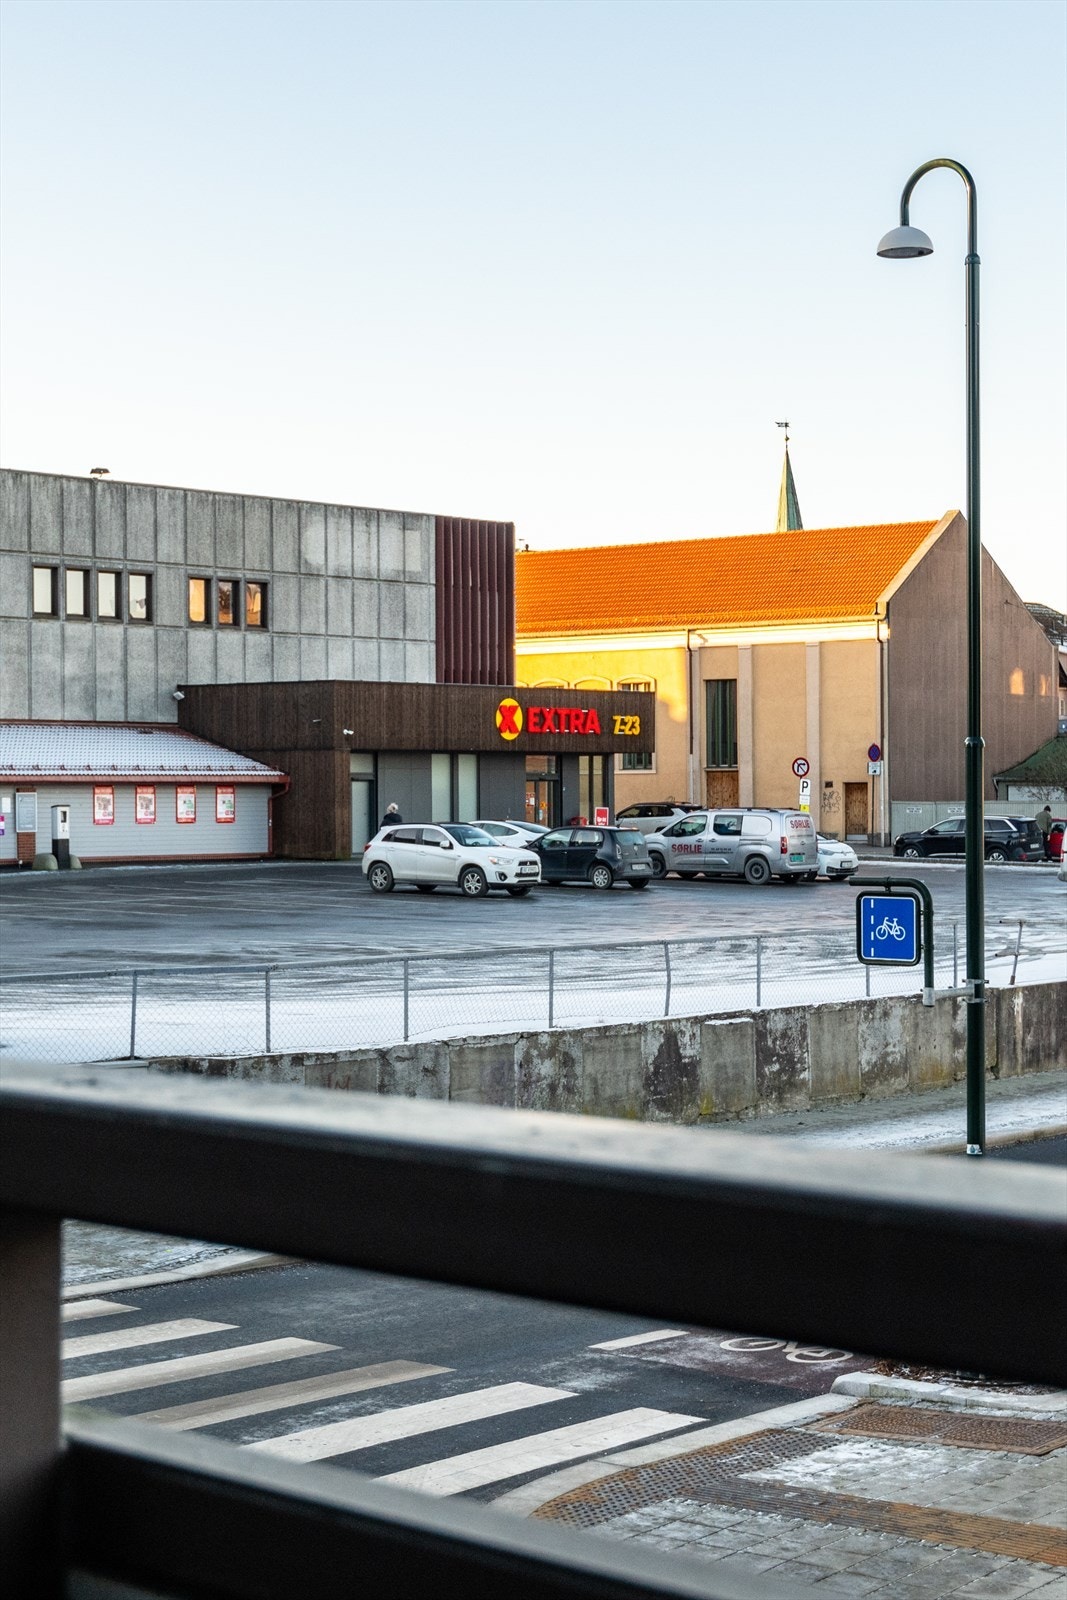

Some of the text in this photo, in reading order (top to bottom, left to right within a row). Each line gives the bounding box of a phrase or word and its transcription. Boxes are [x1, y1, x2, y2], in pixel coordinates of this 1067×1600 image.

[527, 706, 601, 735] EXTRA
[612, 715, 641, 735] 7-23
[801, 780, 809, 793] P
[671, 843, 703, 854] SØRLIE
